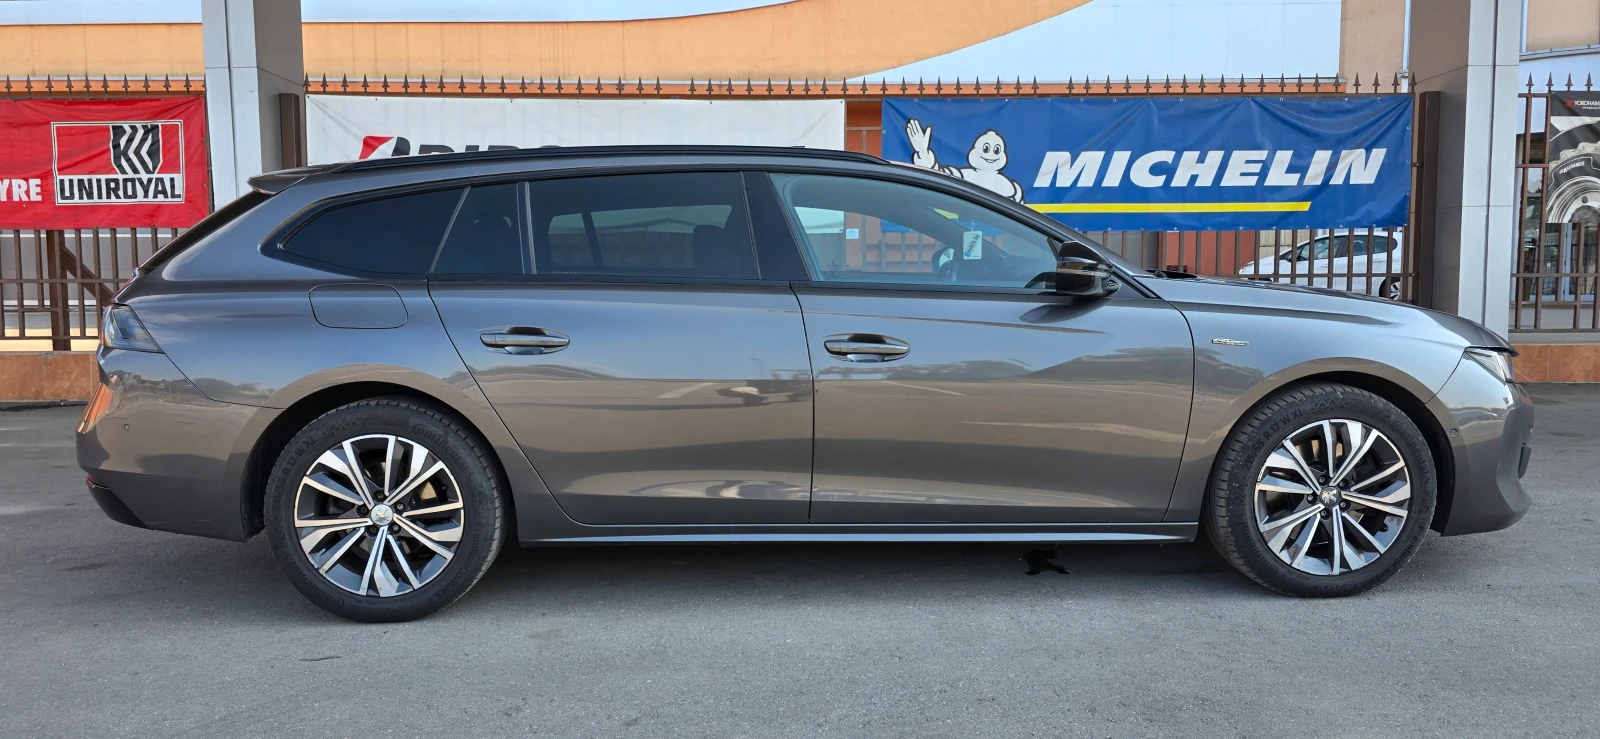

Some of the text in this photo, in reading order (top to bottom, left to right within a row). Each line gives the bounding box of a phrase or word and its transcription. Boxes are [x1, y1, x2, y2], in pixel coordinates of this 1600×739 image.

[59, 177, 181, 200] UNIROYAL
[1032, 148, 1387, 187] MICHELIN
[287, 455, 297, 467] 17
[294, 445, 305, 457] W
[303, 436, 318, 448] XL
[412, 423, 470, 472] Continental
[1242, 409, 1305, 471] 215/55 R 17 W XL
[1392, 421, 1429, 475] Continental
